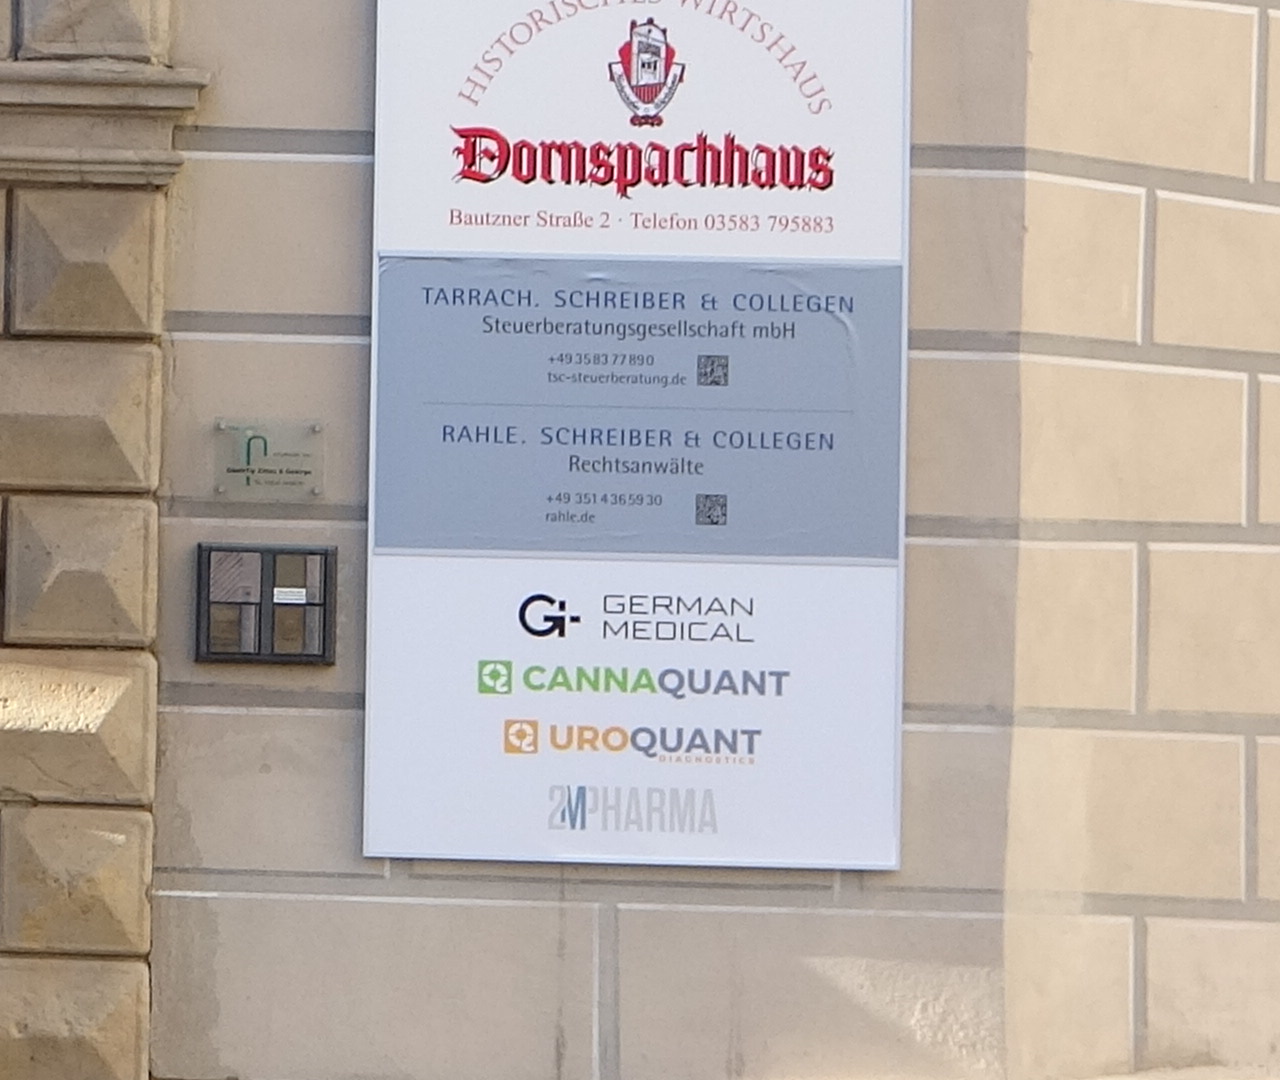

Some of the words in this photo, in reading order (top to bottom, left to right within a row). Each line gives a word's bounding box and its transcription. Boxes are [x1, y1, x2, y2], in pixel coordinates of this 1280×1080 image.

[449, 124, 835, 200] Dornspachhaus
[449, 208, 531, 228] Bautzner
[536, 209, 594, 230] Straße
[599, 213, 610, 229] 2
[630, 211, 698, 231] Telefon
[704, 214, 761, 232] 03583
[768, 215, 835, 234] 795883
[554, 289, 687, 311] SCHREIBER
[732, 293, 855, 314] COLLEGEN
[482, 316, 745, 341] Steuerberatungsgesellschaft
[752, 322, 796, 340] mbH
[540, 426, 673, 448] SCHREIBER
[712, 430, 836, 452] COLLEGEN
[568, 454, 705, 476] Rechtsanwälte
[602, 594, 756, 617] GERMAN
[602, 621, 756, 643] MEDICAL
[523, 665, 791, 700] CANNAQUANT
[549, 724, 763, 758] UROQUANT
